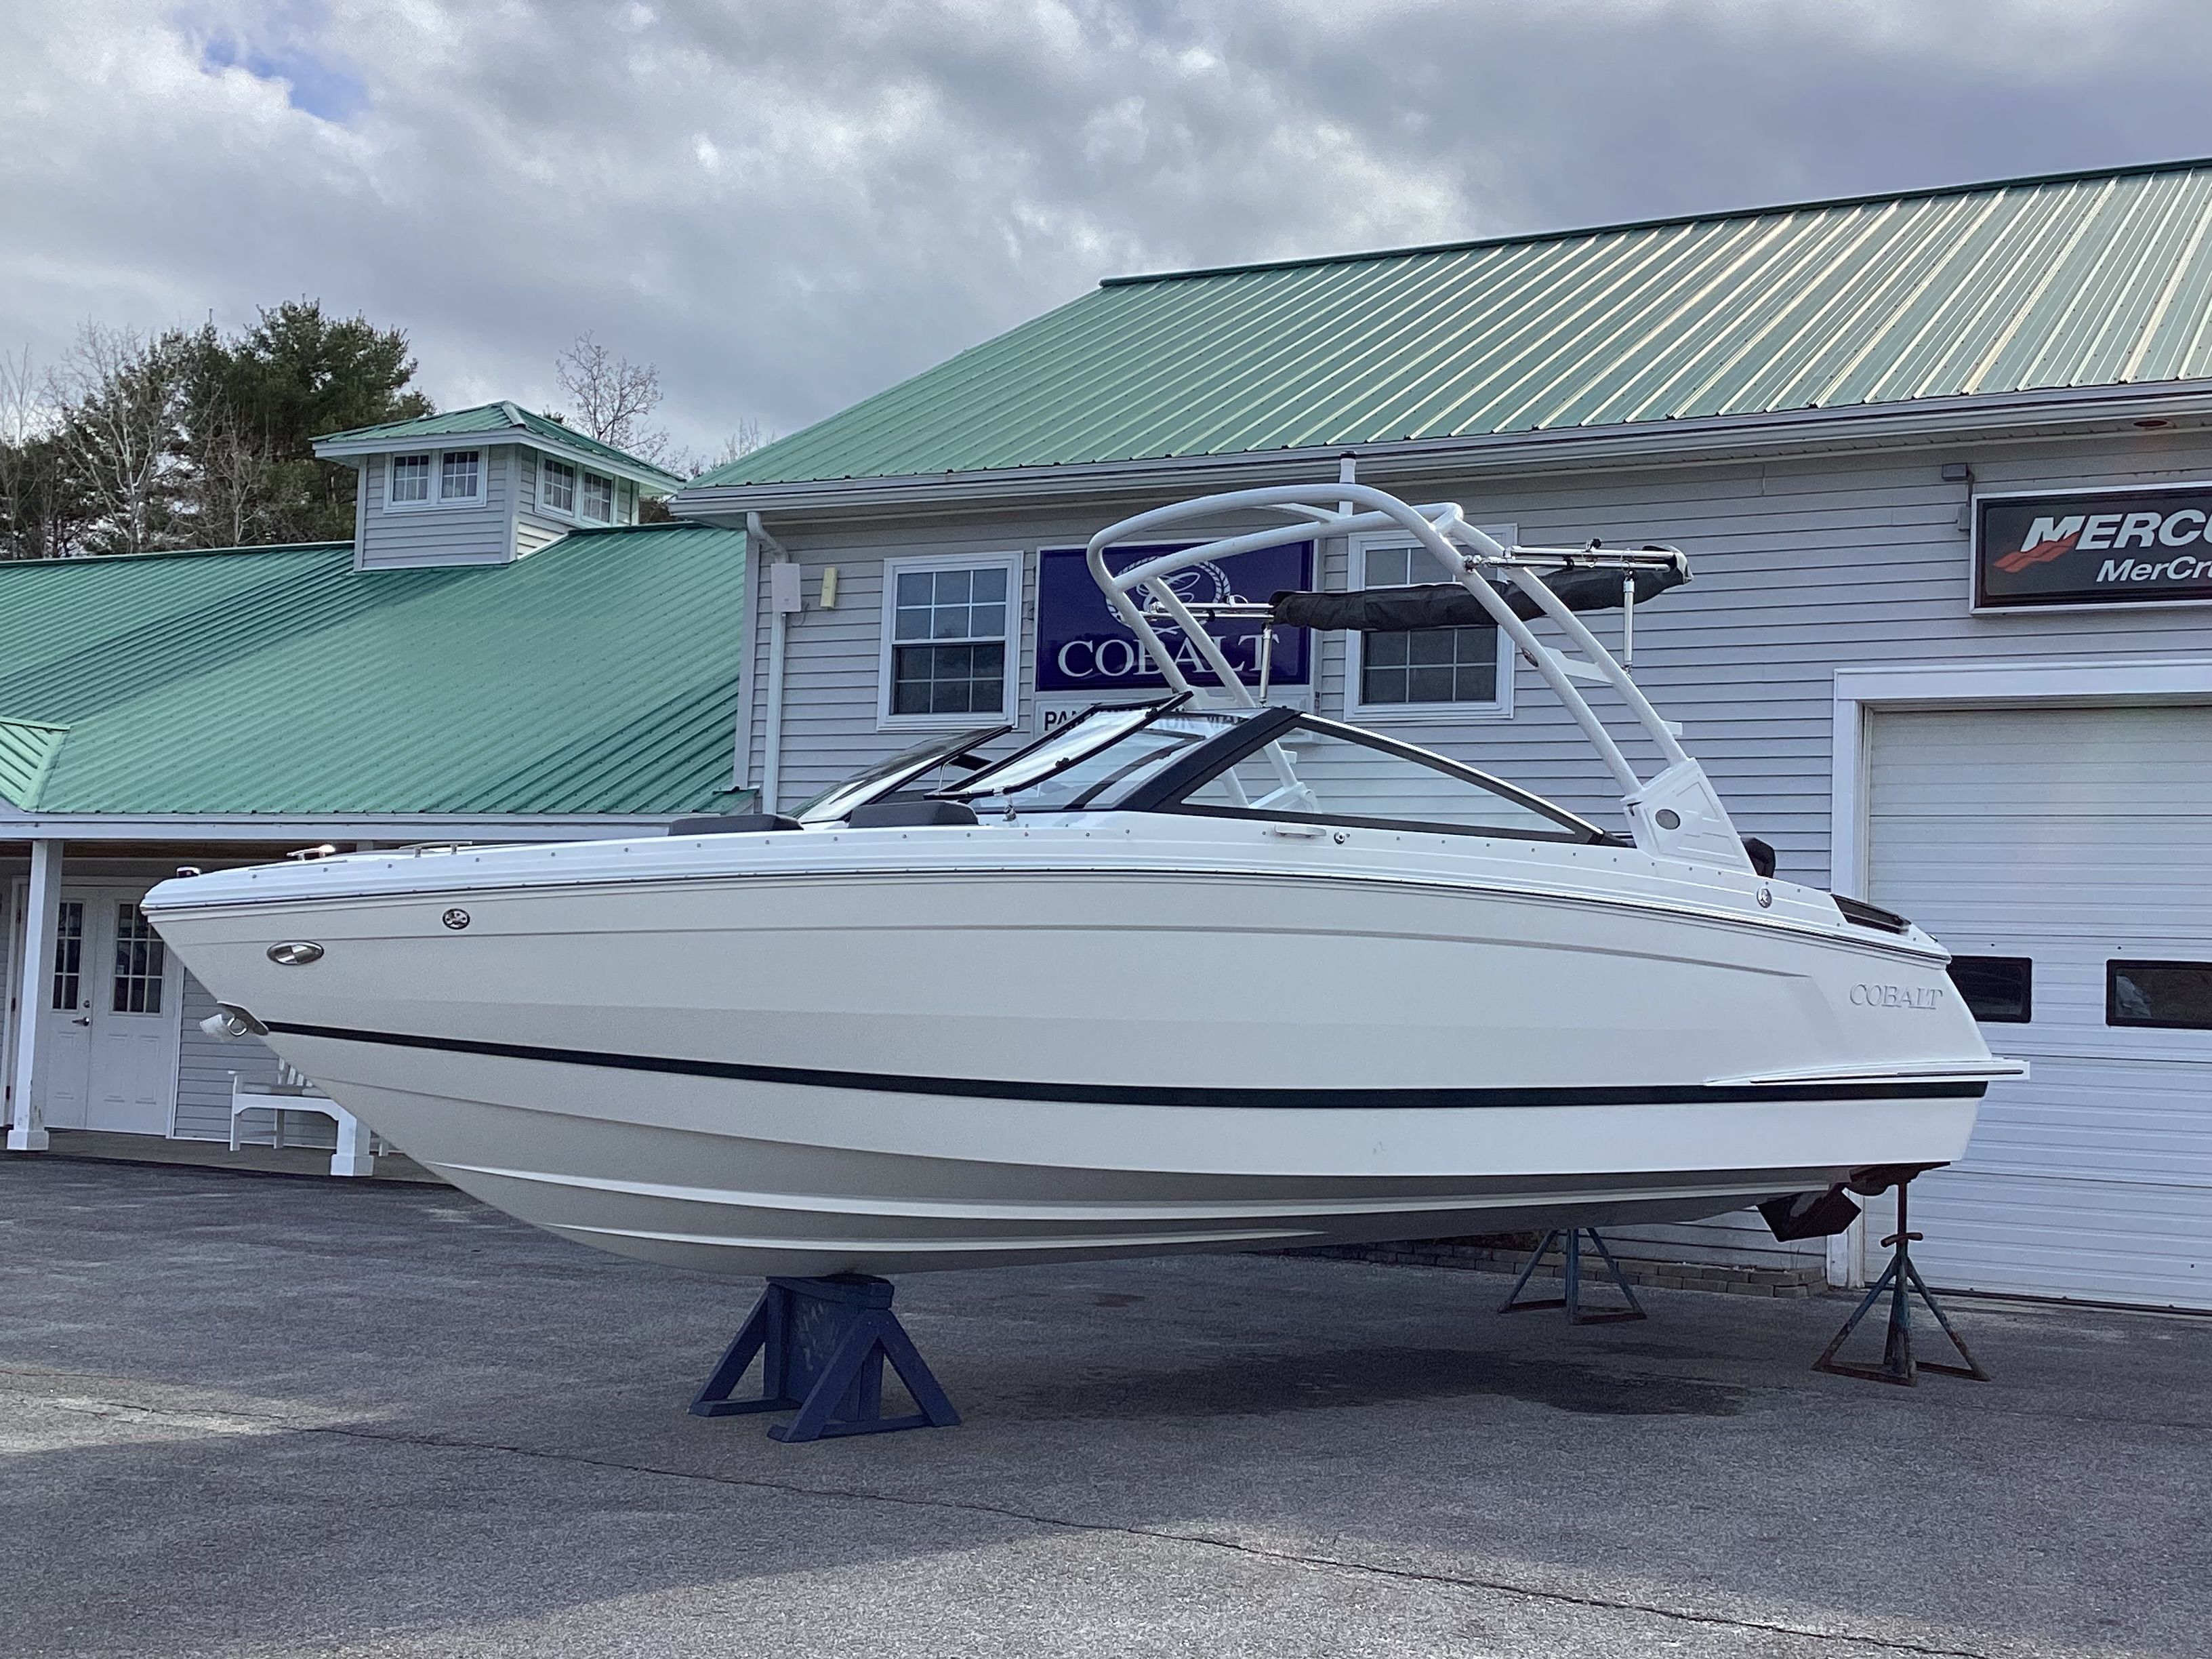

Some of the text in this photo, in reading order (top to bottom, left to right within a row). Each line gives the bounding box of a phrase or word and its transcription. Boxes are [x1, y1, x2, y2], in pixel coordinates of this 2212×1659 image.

[2020, 508, 2212, 553] MERC
[2096, 556, 2212, 583] MerCr
[1849, 983, 1944, 1010] COBALT
